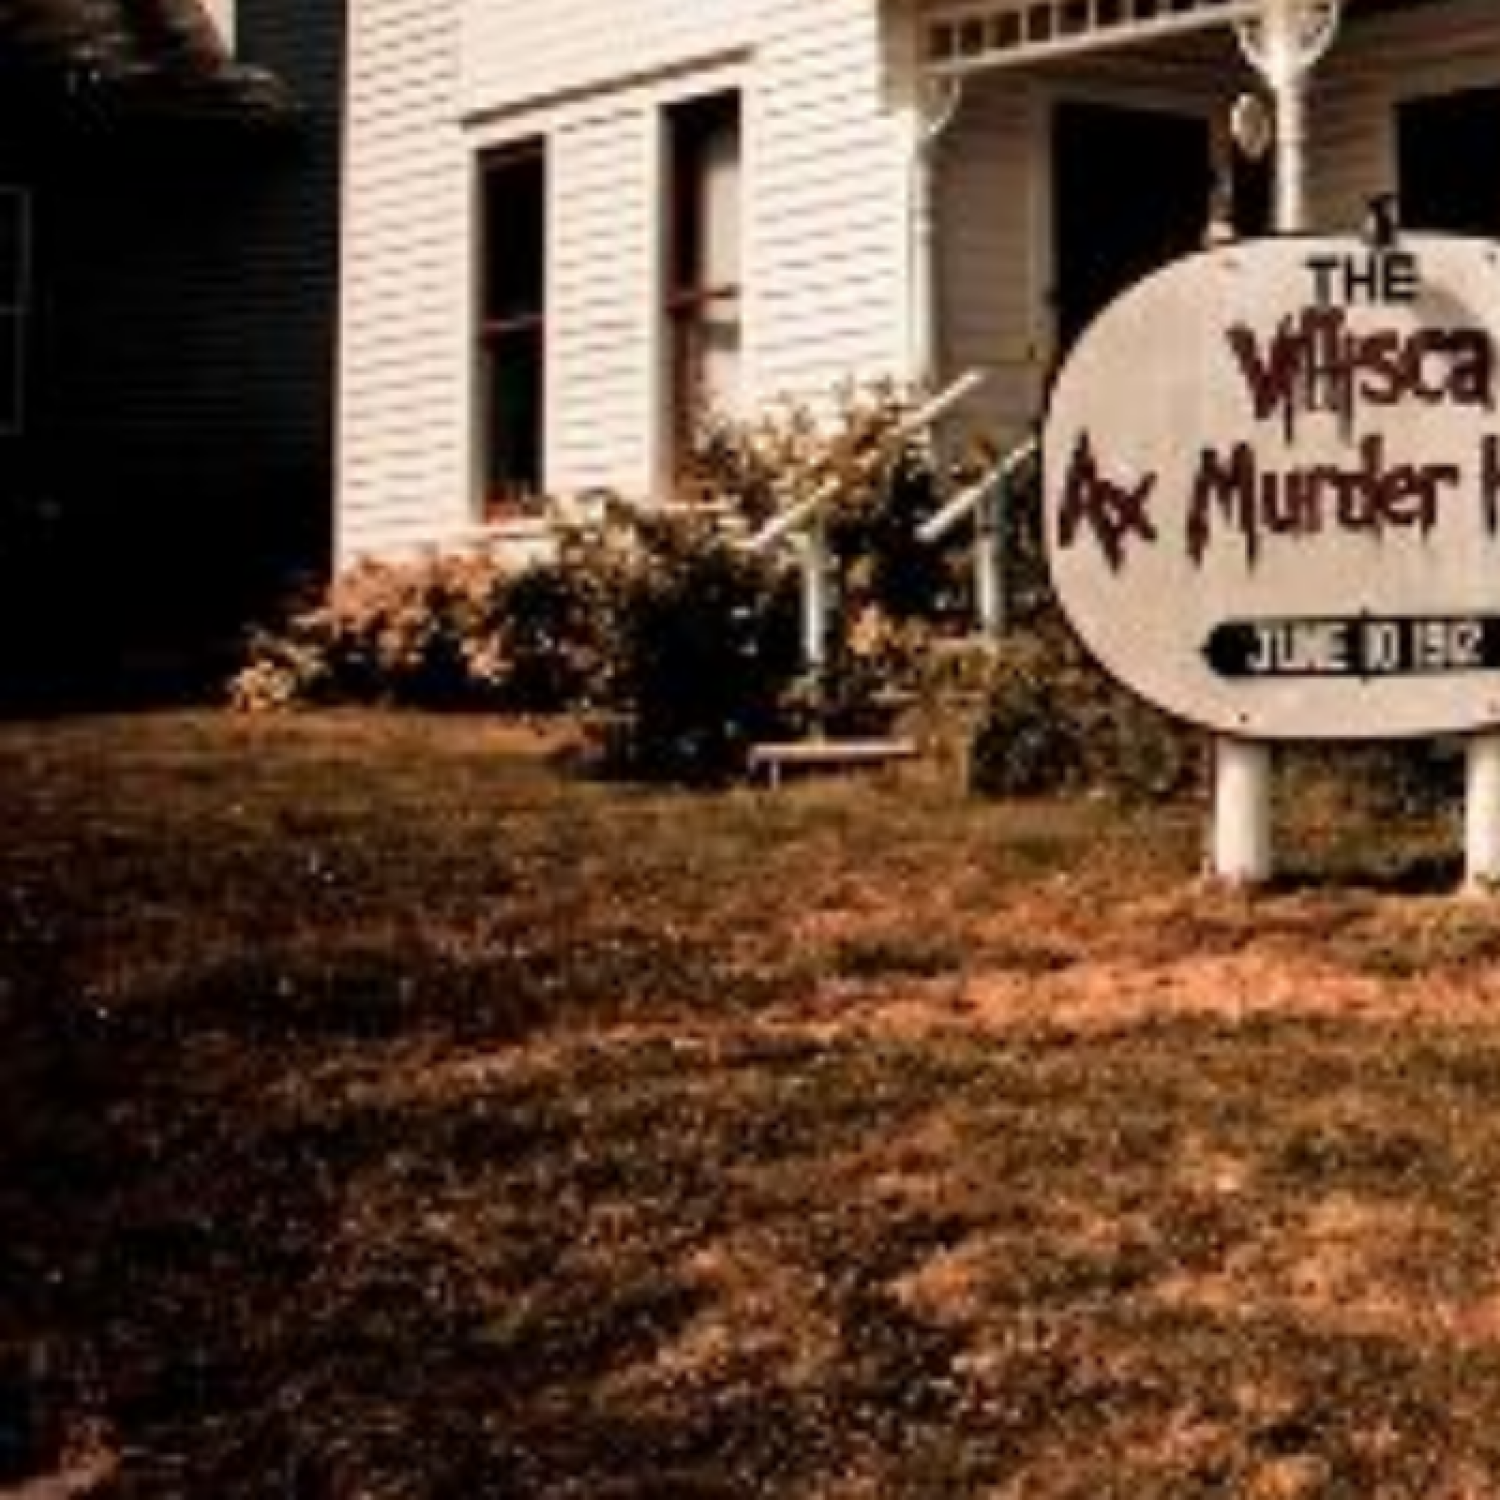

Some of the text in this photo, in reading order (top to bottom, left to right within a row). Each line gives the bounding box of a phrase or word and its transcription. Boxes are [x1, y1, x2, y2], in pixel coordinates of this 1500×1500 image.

[1304, 252, 1419, 303] THE
[1057, 430, 1158, 574] Ax
[1187, 434, 1461, 574] Murder
[1245, 622, 1348, 672] JUNE
[1362, 621, 1401, 672] 10
